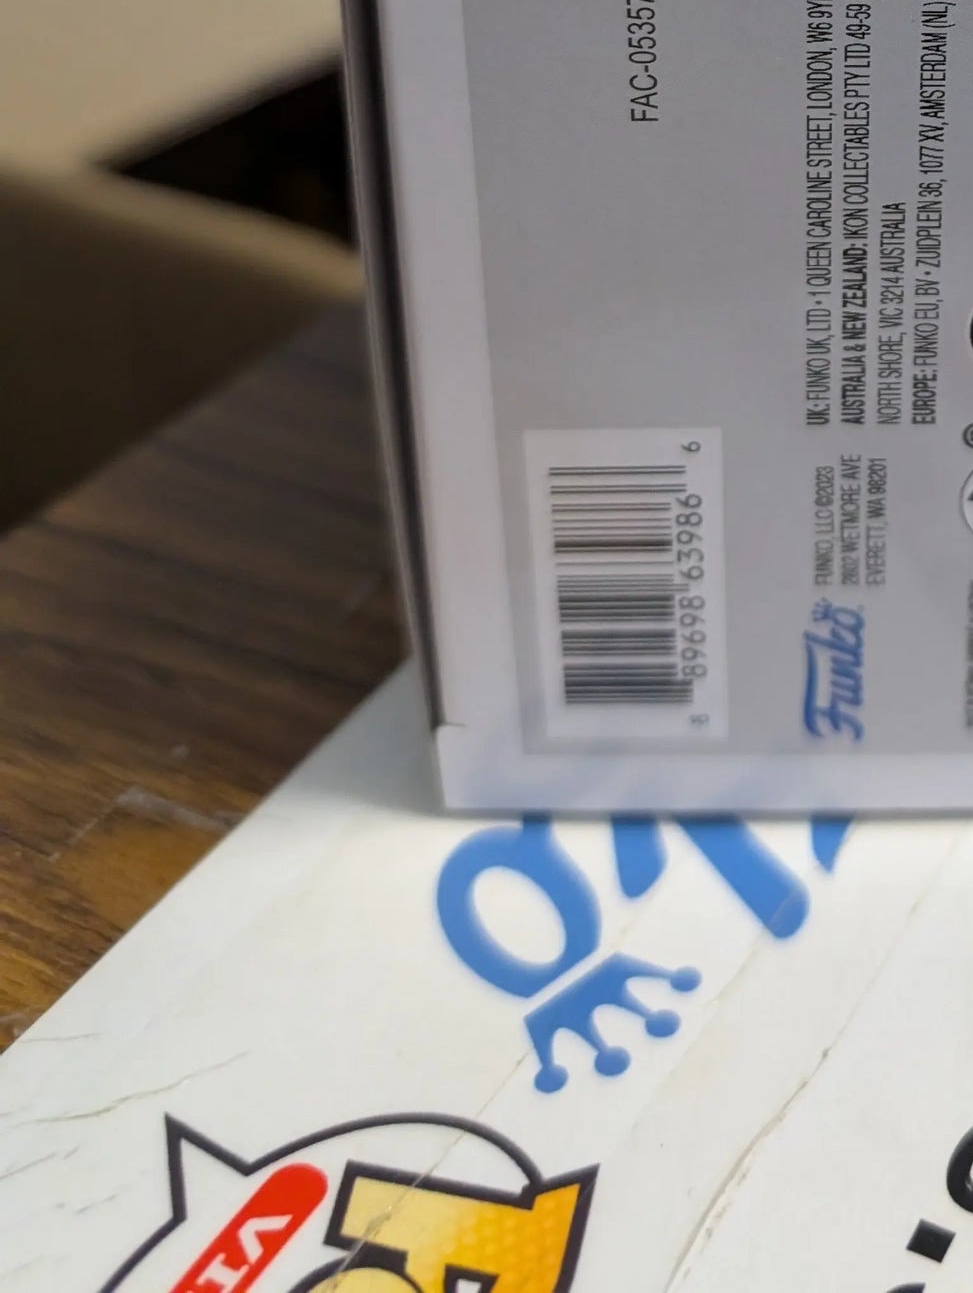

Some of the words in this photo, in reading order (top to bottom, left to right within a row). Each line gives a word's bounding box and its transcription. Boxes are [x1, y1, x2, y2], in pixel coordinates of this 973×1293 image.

[806, 22, 833, 43] W6
[844, 3, 871, 40] 49-59
[921, 1, 955, 28] (NL)
[844, 43, 871, 68] LTD
[806, 48, 835, 110] LONDON,
[843, 72, 870, 98] PTY
[919, 32, 947, 119] AMSTERDAM
[806, 112, 835, 168] STREET,
[919, 122, 948, 143] XV,
[843, 102, 870, 204] COLLECTABLES
[918, 146, 944, 174] 1077
[806, 171, 832, 239] CAROLINE
[917, 179, 946, 198] 36,
[842, 208, 869, 239] IKON
[880, 202, 906, 273] AUSTRALIA
[916, 201, 942, 268] ZUIDPLEIN
[806, 241, 831, 287] QUEEN
[842, 243, 868, 308] ZEALAND:
[879, 277, 904, 305] 3214
[915, 279, 940, 296] BV
[806, 308, 831, 332] LTD
[842, 311, 867, 339] NEW
[879, 308, 904, 328] VIC
[914, 299, 943, 319] EU,
[806, 335, 834, 355] UK,
[842, 344, 867, 352] &
[878, 332, 906, 378] SHORE,
[913, 323, 939, 366] FUNKO
[806, 358, 830, 401] FUNKO
[841, 355, 867, 424] AUSTRALIA
[912, 369, 938, 424] EUROPE:
[806, 403, 830, 425] UK:
[877, 381, 902, 424] NORTH
[681, 441, 701, 453] 6
[841, 454, 861, 481] AVE
[866, 457, 887, 495] 98201
[840, 485, 861, 553] WETMORE
[866, 498, 887, 519] WA
[675, 493, 704, 580] 63986
[677, 595, 707, 679] 89698
[803, 598, 865, 740] Funko
